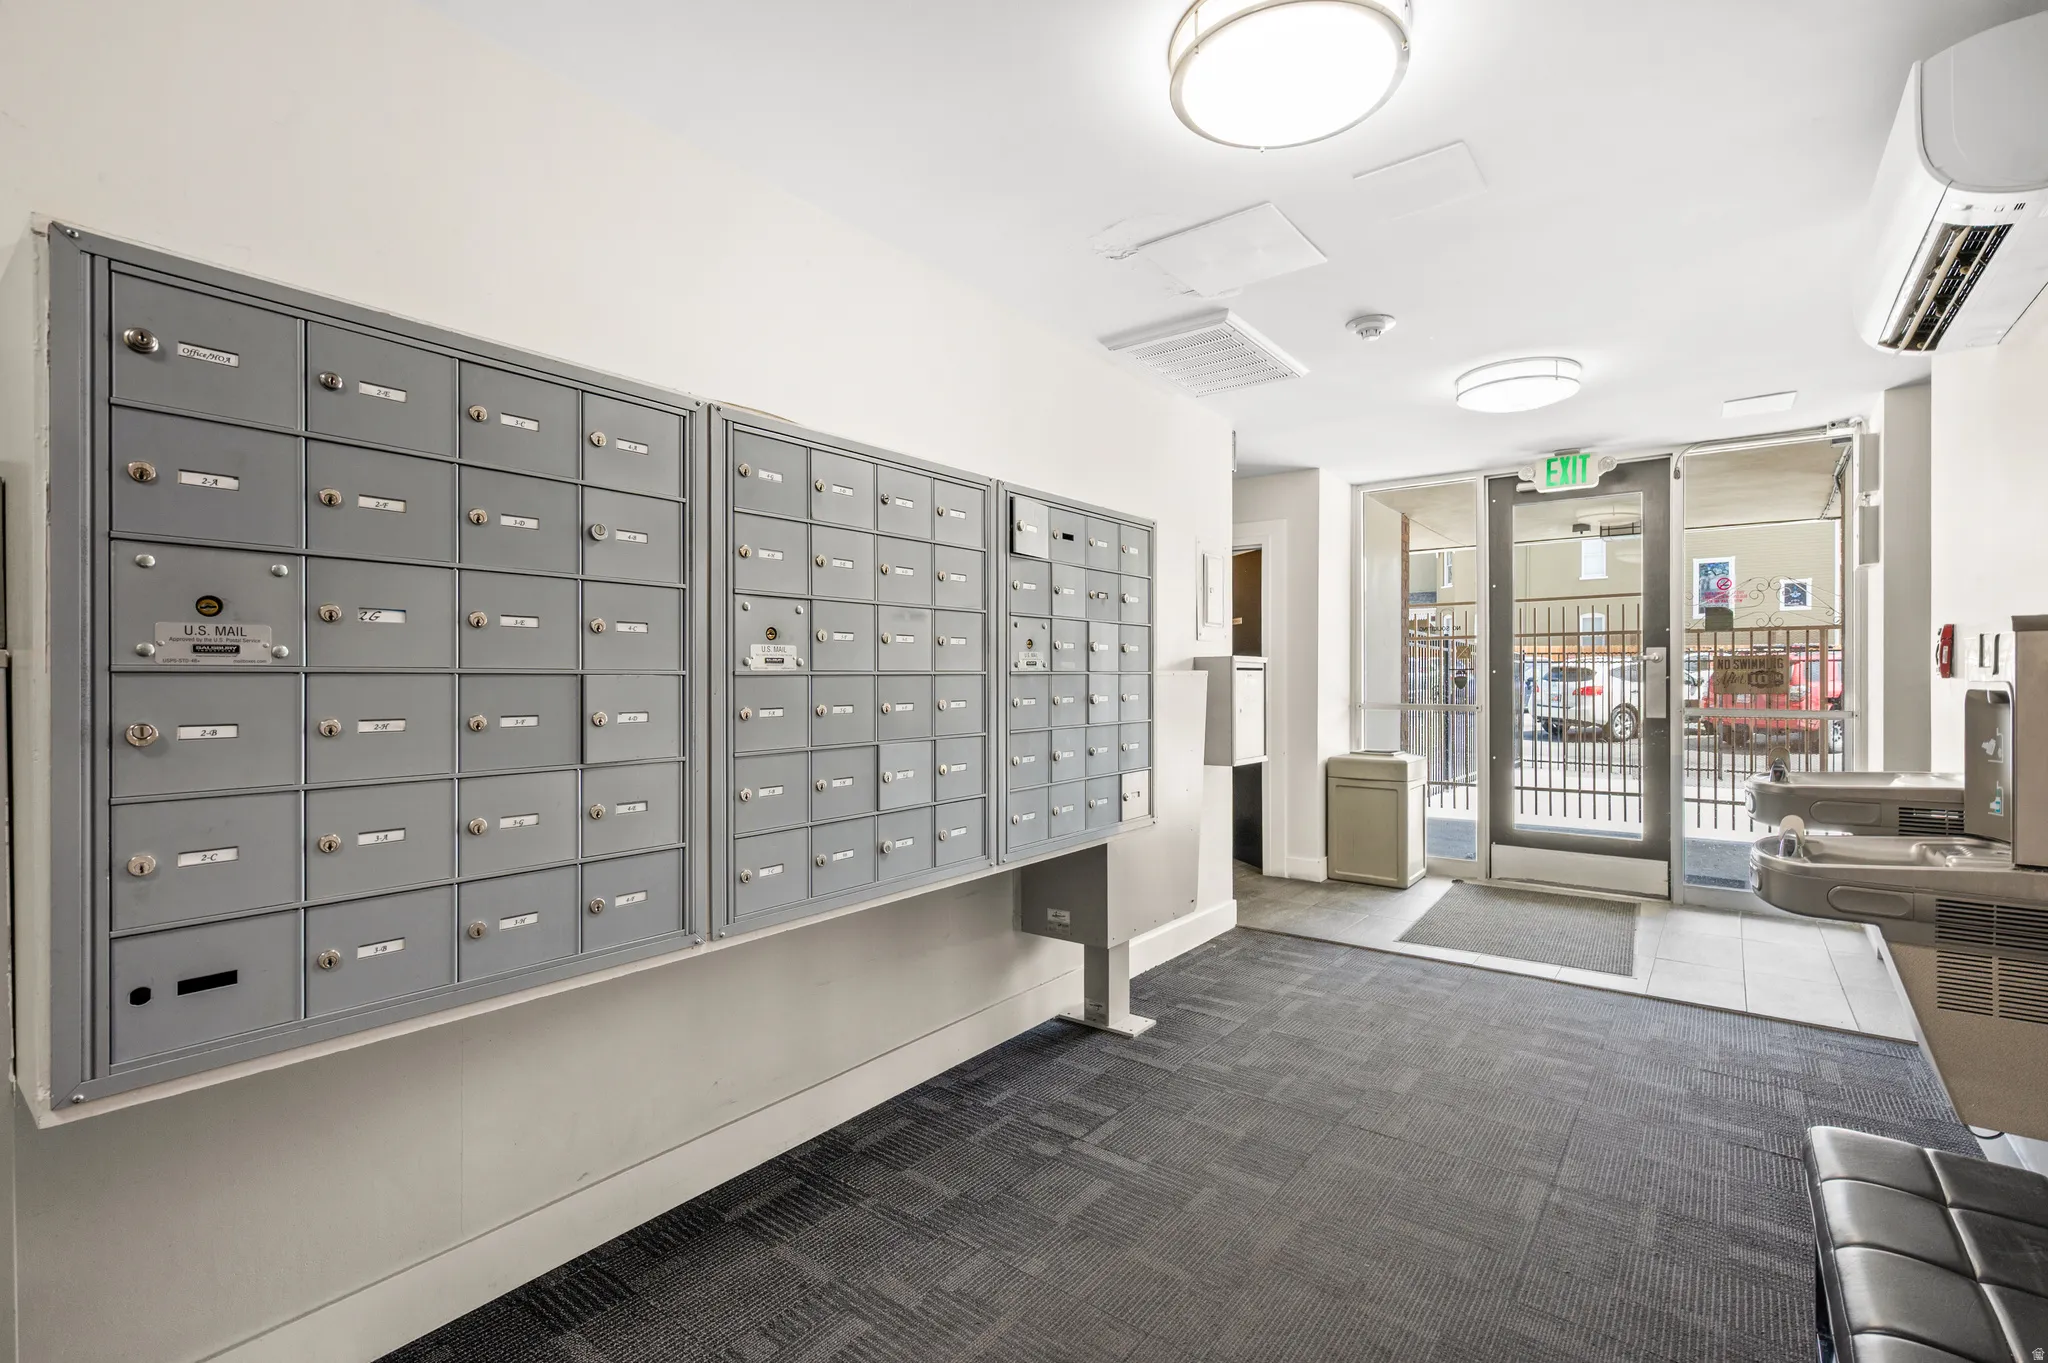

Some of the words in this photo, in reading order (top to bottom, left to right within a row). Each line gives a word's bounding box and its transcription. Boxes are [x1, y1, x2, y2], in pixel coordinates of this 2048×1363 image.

[182, 347, 232, 364] Office/HOA
[376, 389, 390, 398] 2-E
[1545, 453, 1591, 487] EXIT
[202, 477, 218, 487] 2-A
[184, 625, 210, 636] U.S.
[215, 626, 247, 637] MAIL
[1717, 659, 1730, 670] NO
[200, 729, 218, 737] 2-B
[201, 853, 218, 862] 2-C
